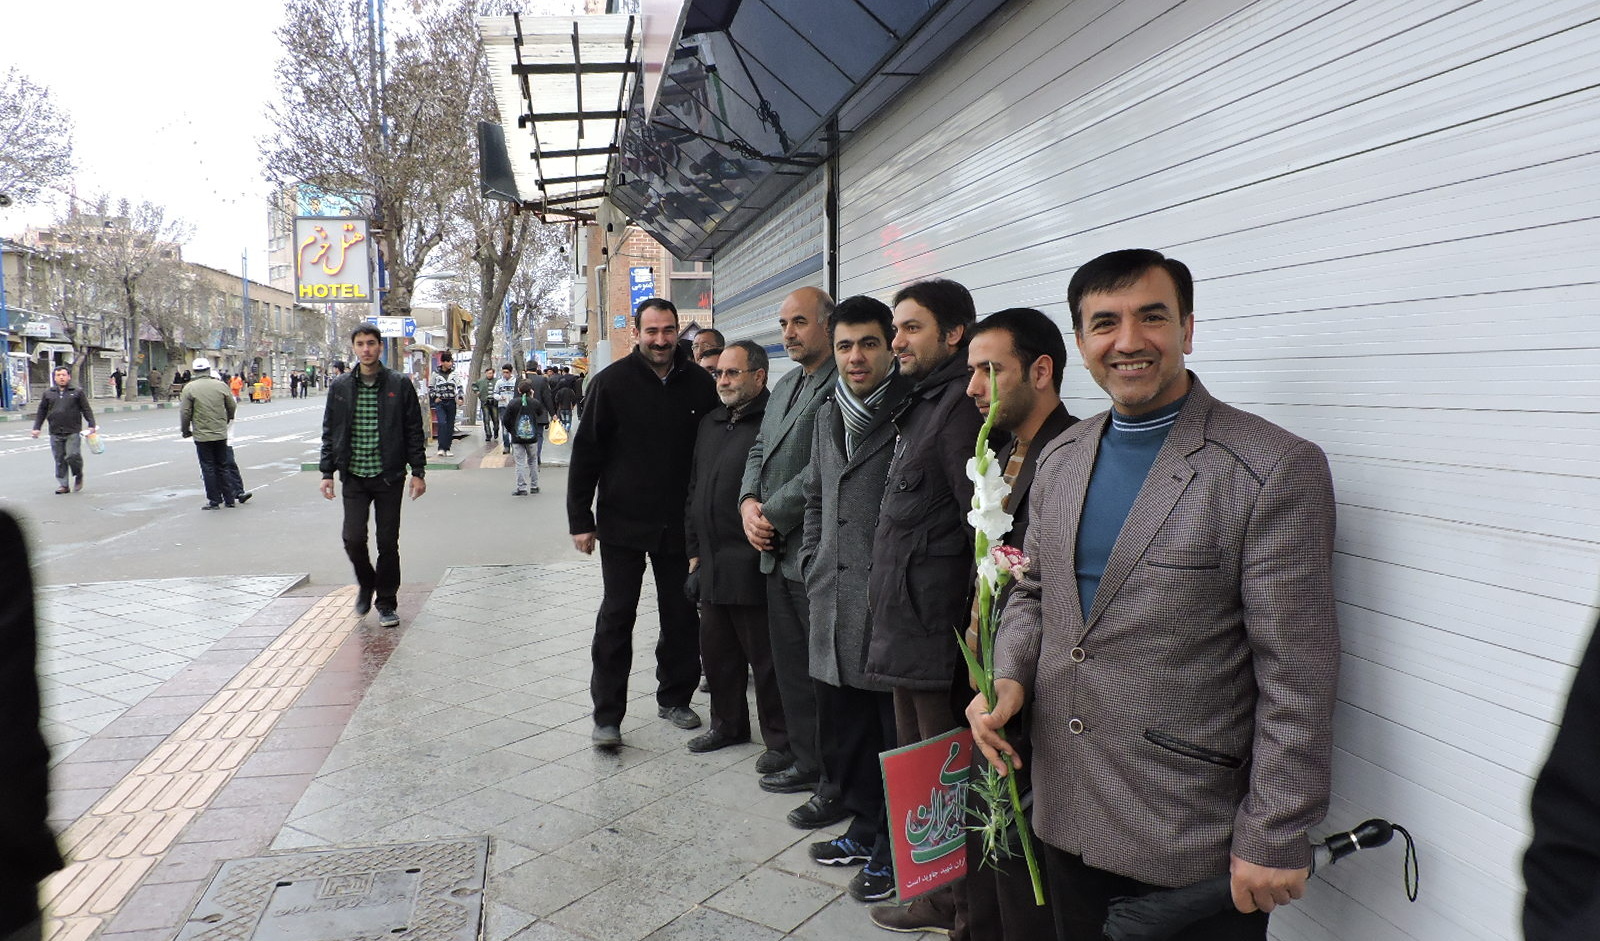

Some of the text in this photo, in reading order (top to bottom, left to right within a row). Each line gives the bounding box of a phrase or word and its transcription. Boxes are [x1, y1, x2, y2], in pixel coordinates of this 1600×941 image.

[323, 223, 365, 276] هتل
[299, 284, 367, 298] HOTEL
[906, 876, 921, 888] است
